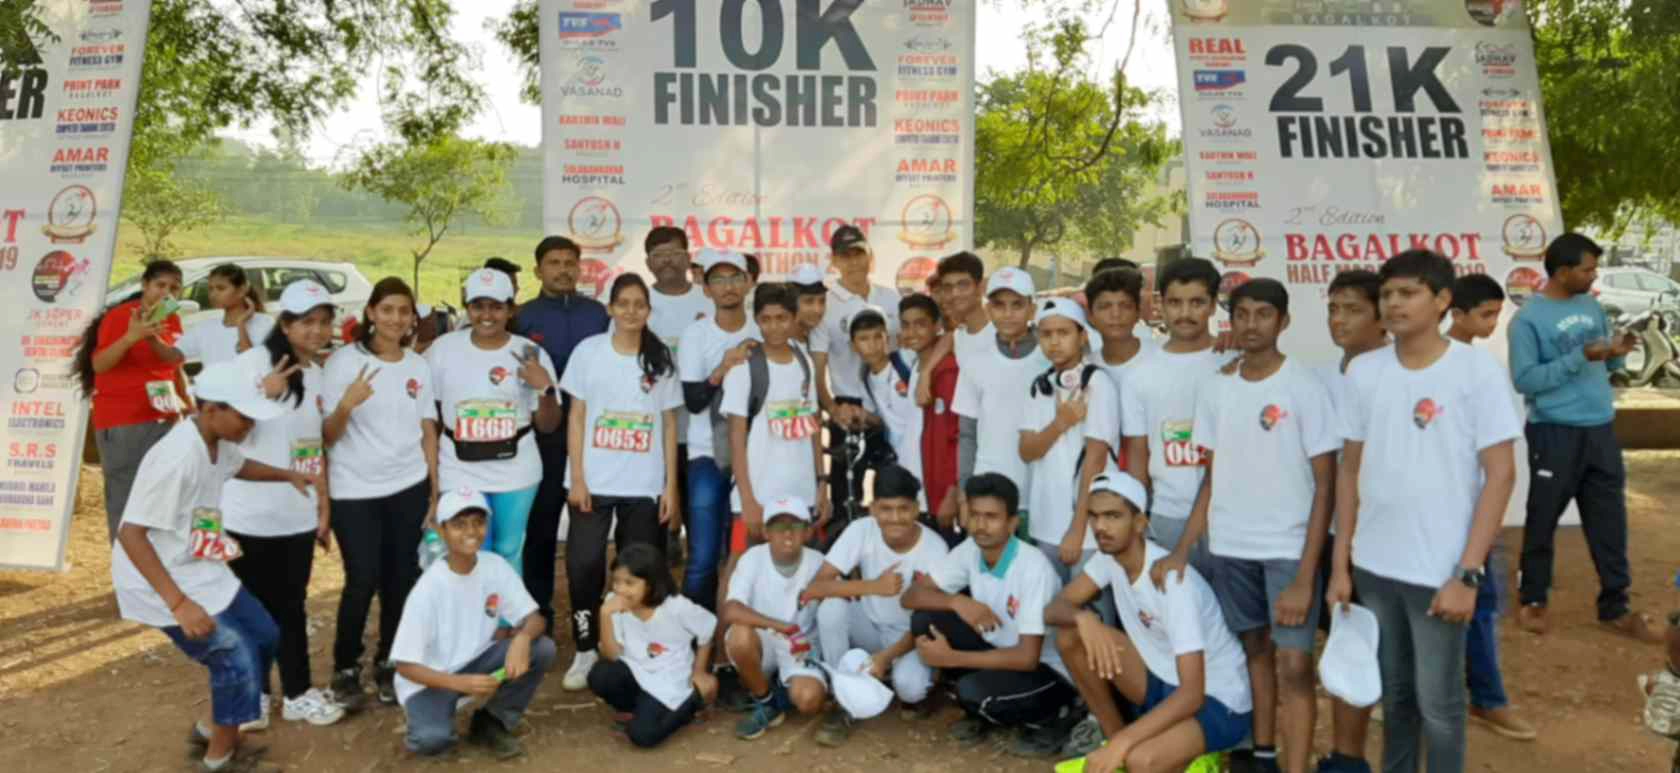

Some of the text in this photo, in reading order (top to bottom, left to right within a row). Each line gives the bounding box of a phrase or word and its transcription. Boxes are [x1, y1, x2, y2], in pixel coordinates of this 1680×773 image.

[650, 0, 878, 71] 10K
[1188, 38, 1247, 54] REAL
[897, 55, 957, 65] FOREVER
[1264, 44, 1463, 113] 21K
[654, 72, 878, 127] FINISHER
[57, 106, 119, 122] KEONICS
[895, 119, 960, 132] KEONICS
[1276, 116, 1469, 158] FINISHER
[53, 147, 109, 162] AMAR
[896, 159, 957, 173] AMAR
[562, 175, 626, 184] HOSPITAL
[1491, 184, 1541, 197] AMAR
[1206, 200, 1261, 208] HOSPITAL
[1319, 205, 1385, 226] Edition
[1287, 264, 1329, 284] HALF
[11, 401, 65, 417] INTEL
[459, 416, 514, 440] 1668
[595, 428, 649, 451] 0653
